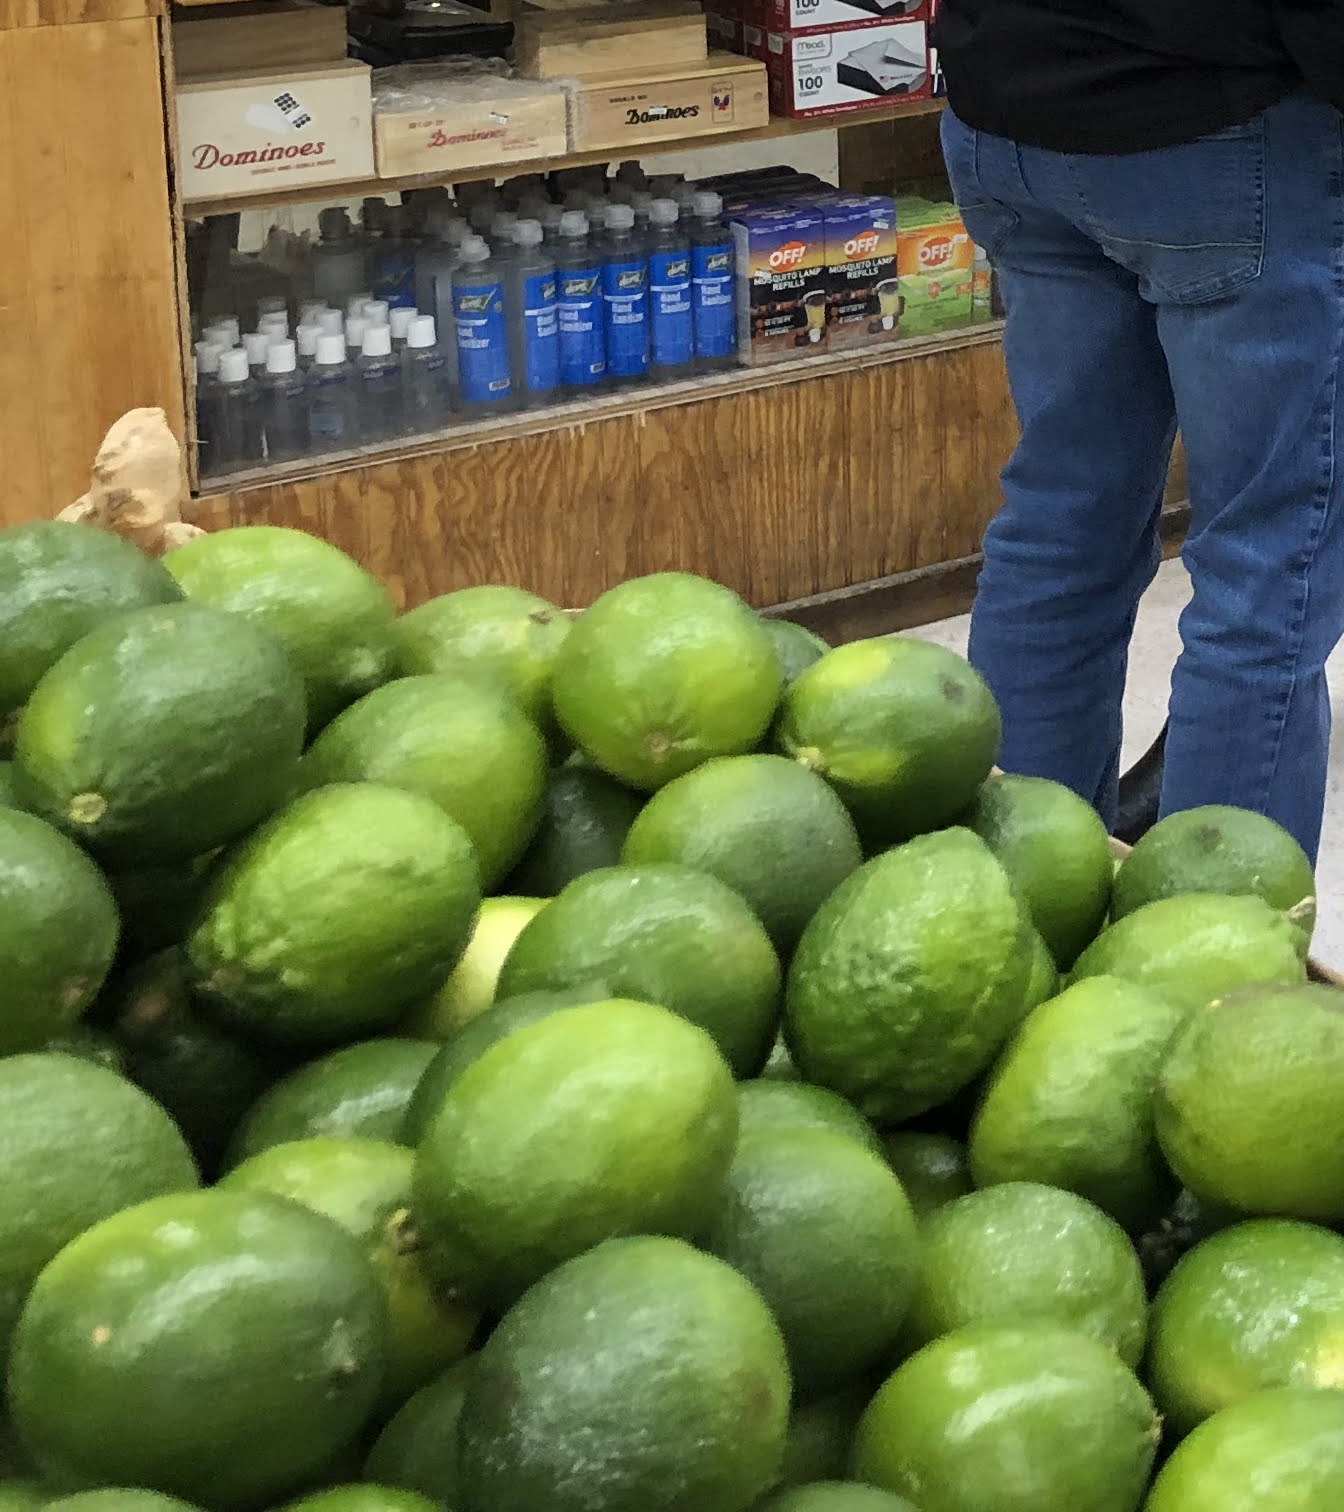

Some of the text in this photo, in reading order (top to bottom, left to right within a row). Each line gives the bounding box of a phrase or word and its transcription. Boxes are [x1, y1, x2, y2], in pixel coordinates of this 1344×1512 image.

[795, 8, 816, 16] COUNT
[798, 75, 823, 91] 100
[799, 89, 820, 98] COUNT
[192, 140, 326, 170] Dominoes
[844, 234, 880, 256] OFF!
[918, 240, 955, 263] OFF!
[769, 243, 807, 267] OFF!
[799, 267, 821, 279] LAMP
[828, 256, 895, 275] MOSQUITO LAMP
[847, 267, 879, 280] REFILLS
[772, 279, 805, 292] REFILLS
